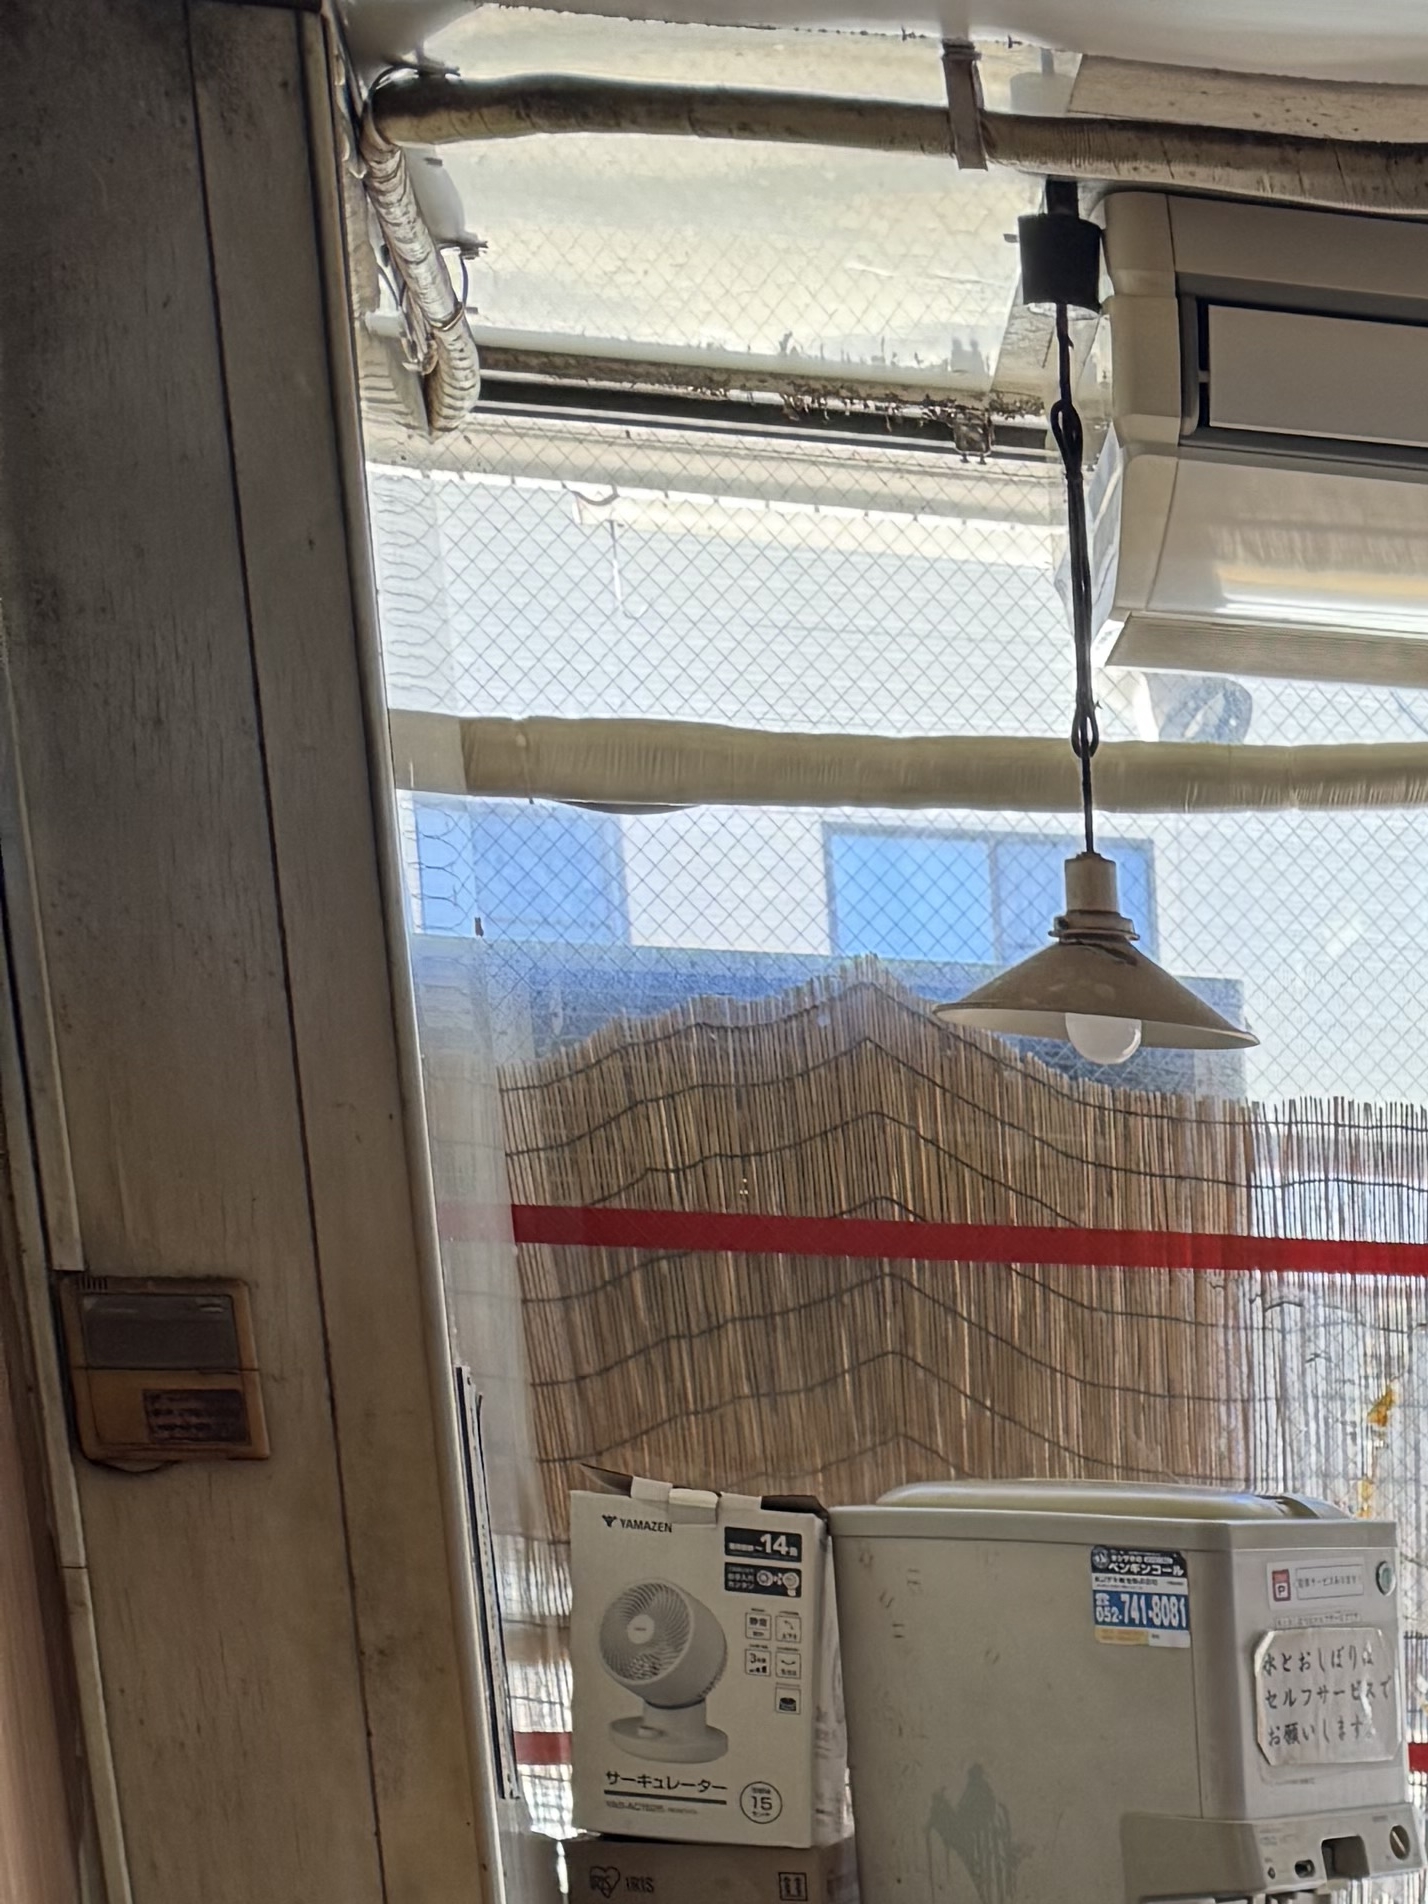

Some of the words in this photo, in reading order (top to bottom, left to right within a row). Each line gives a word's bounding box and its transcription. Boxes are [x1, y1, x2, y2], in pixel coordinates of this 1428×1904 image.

[620, 1517, 673, 1533] YAMAZEN
[1107, 1562, 1185, 1577] ペンギンコール
[605, 1769, 729, 1794] サーキュレーター
